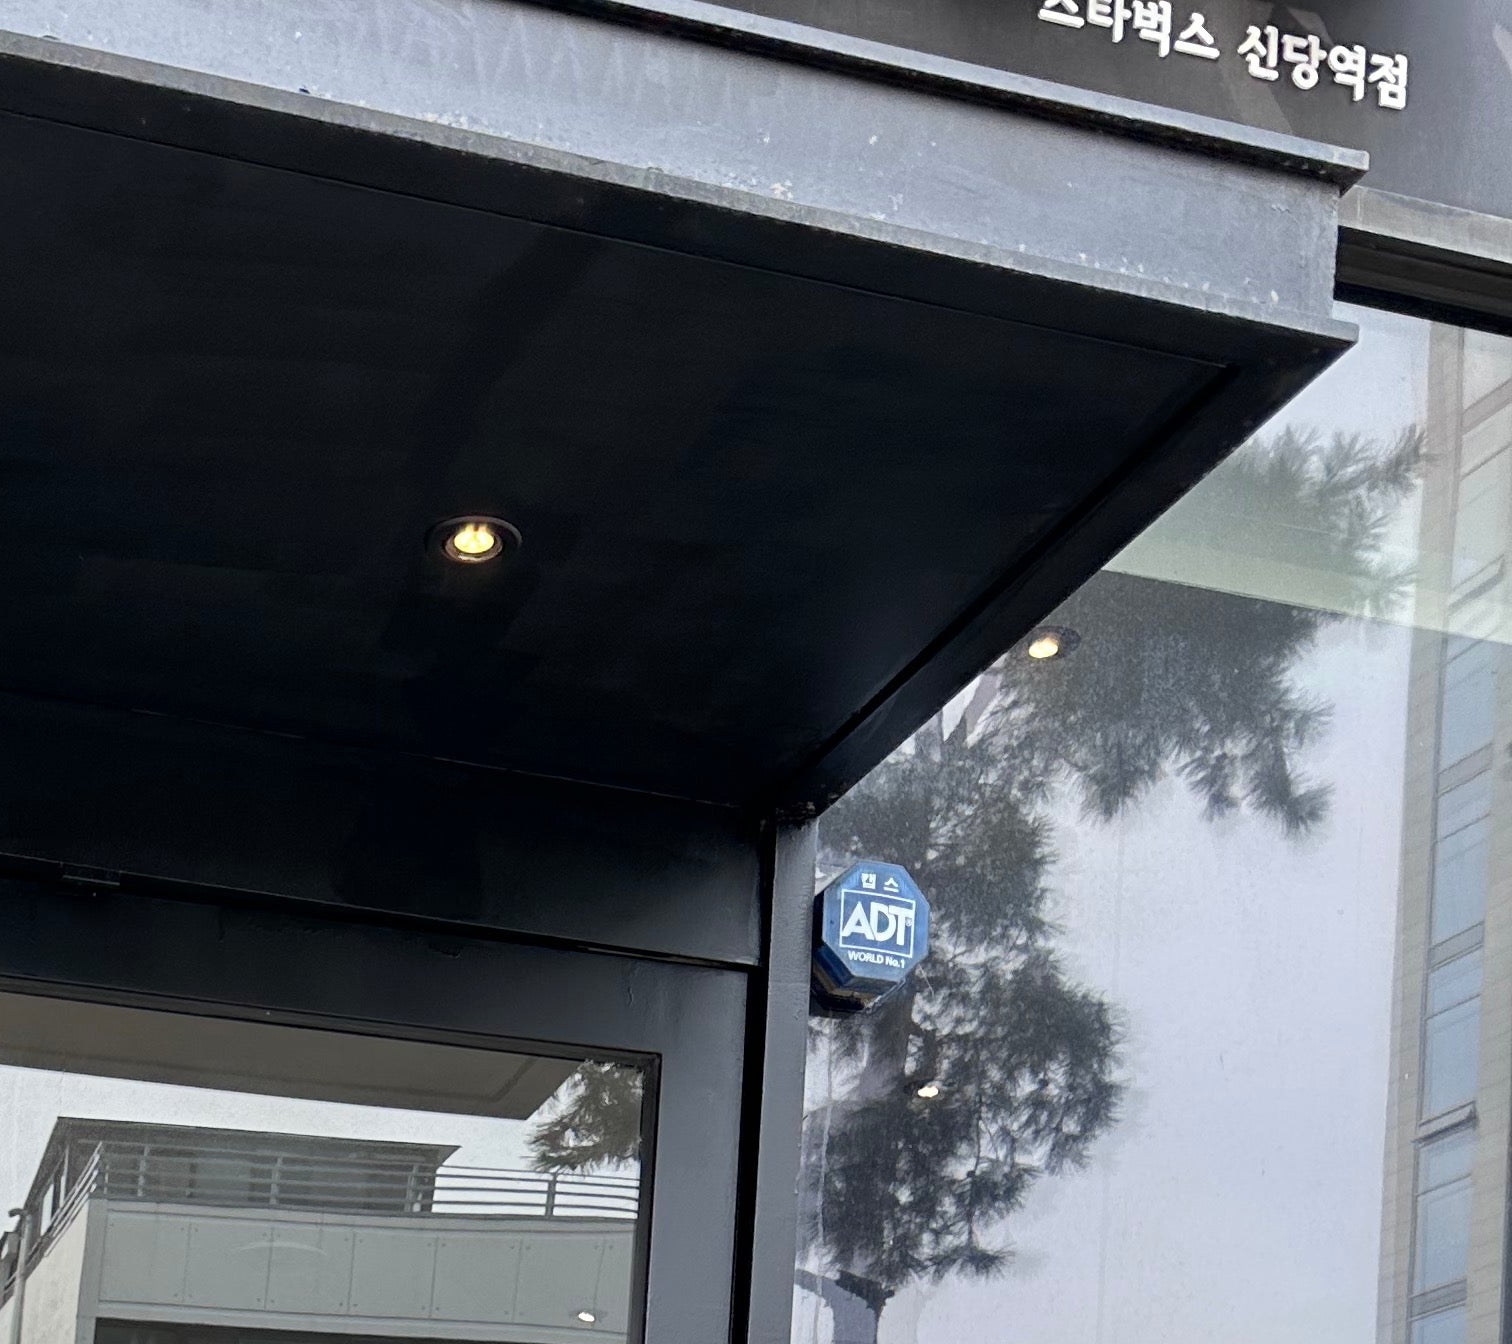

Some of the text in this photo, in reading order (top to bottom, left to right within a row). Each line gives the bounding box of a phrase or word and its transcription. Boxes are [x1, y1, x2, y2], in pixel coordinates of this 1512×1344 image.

[1037, 0, 1409, 111] 스타벅스 신당역점
[842, 901, 913, 946] ADT
[847, 950, 884, 964] WORLD
